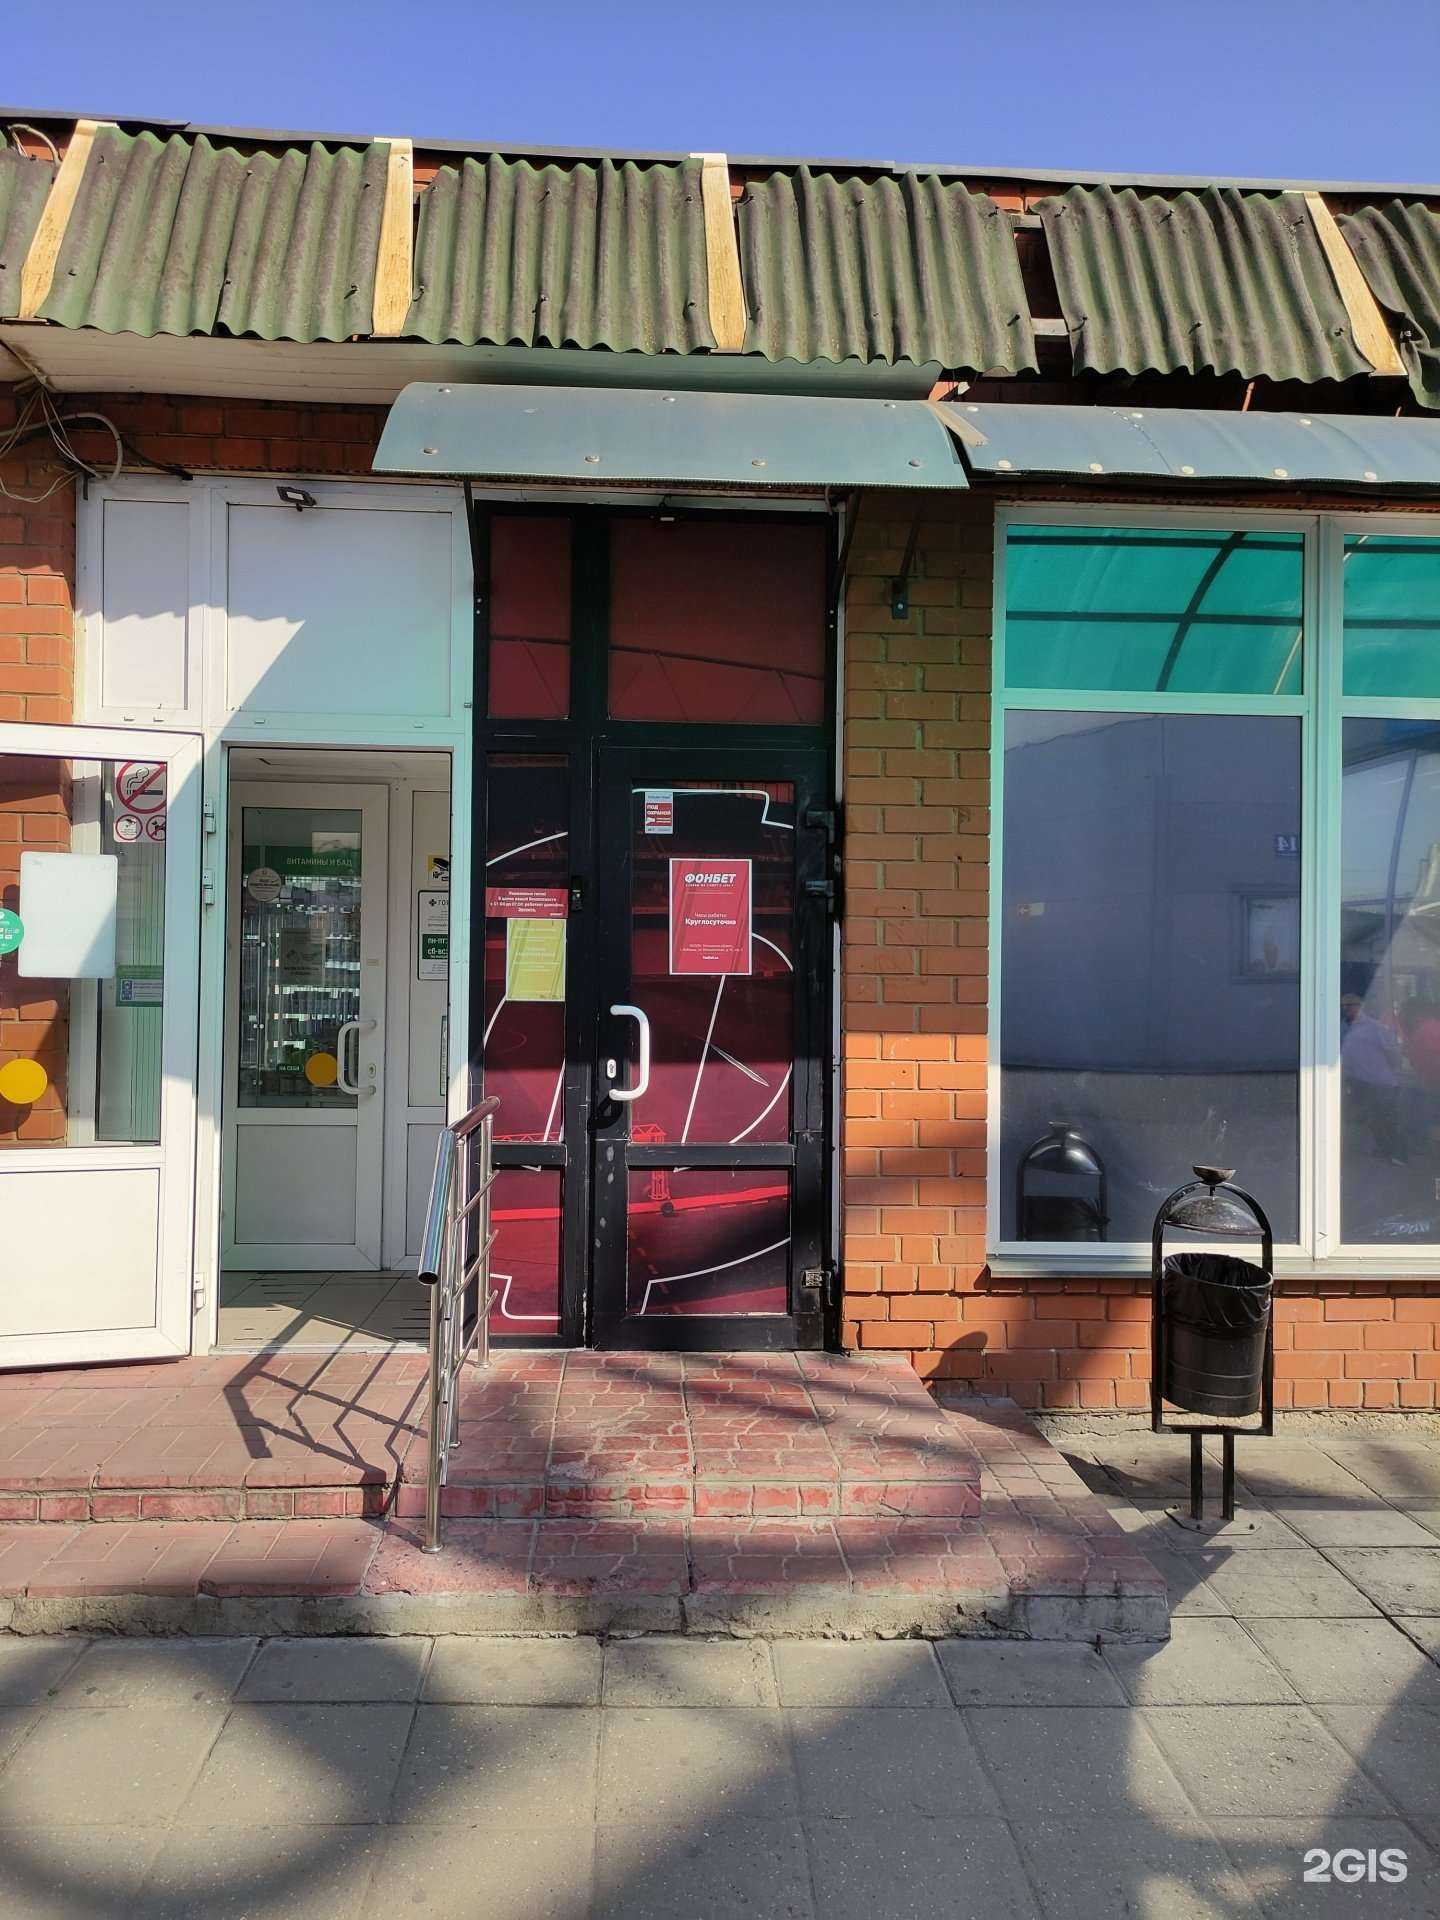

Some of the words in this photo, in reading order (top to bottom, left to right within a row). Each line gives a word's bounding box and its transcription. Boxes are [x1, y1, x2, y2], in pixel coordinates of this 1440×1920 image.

[286, 857, 328, 866] ВИТАМИНЫ
[684, 873, 737, 884] ФОНБЕТ
[685, 918, 737, 926] Круглосуточно
